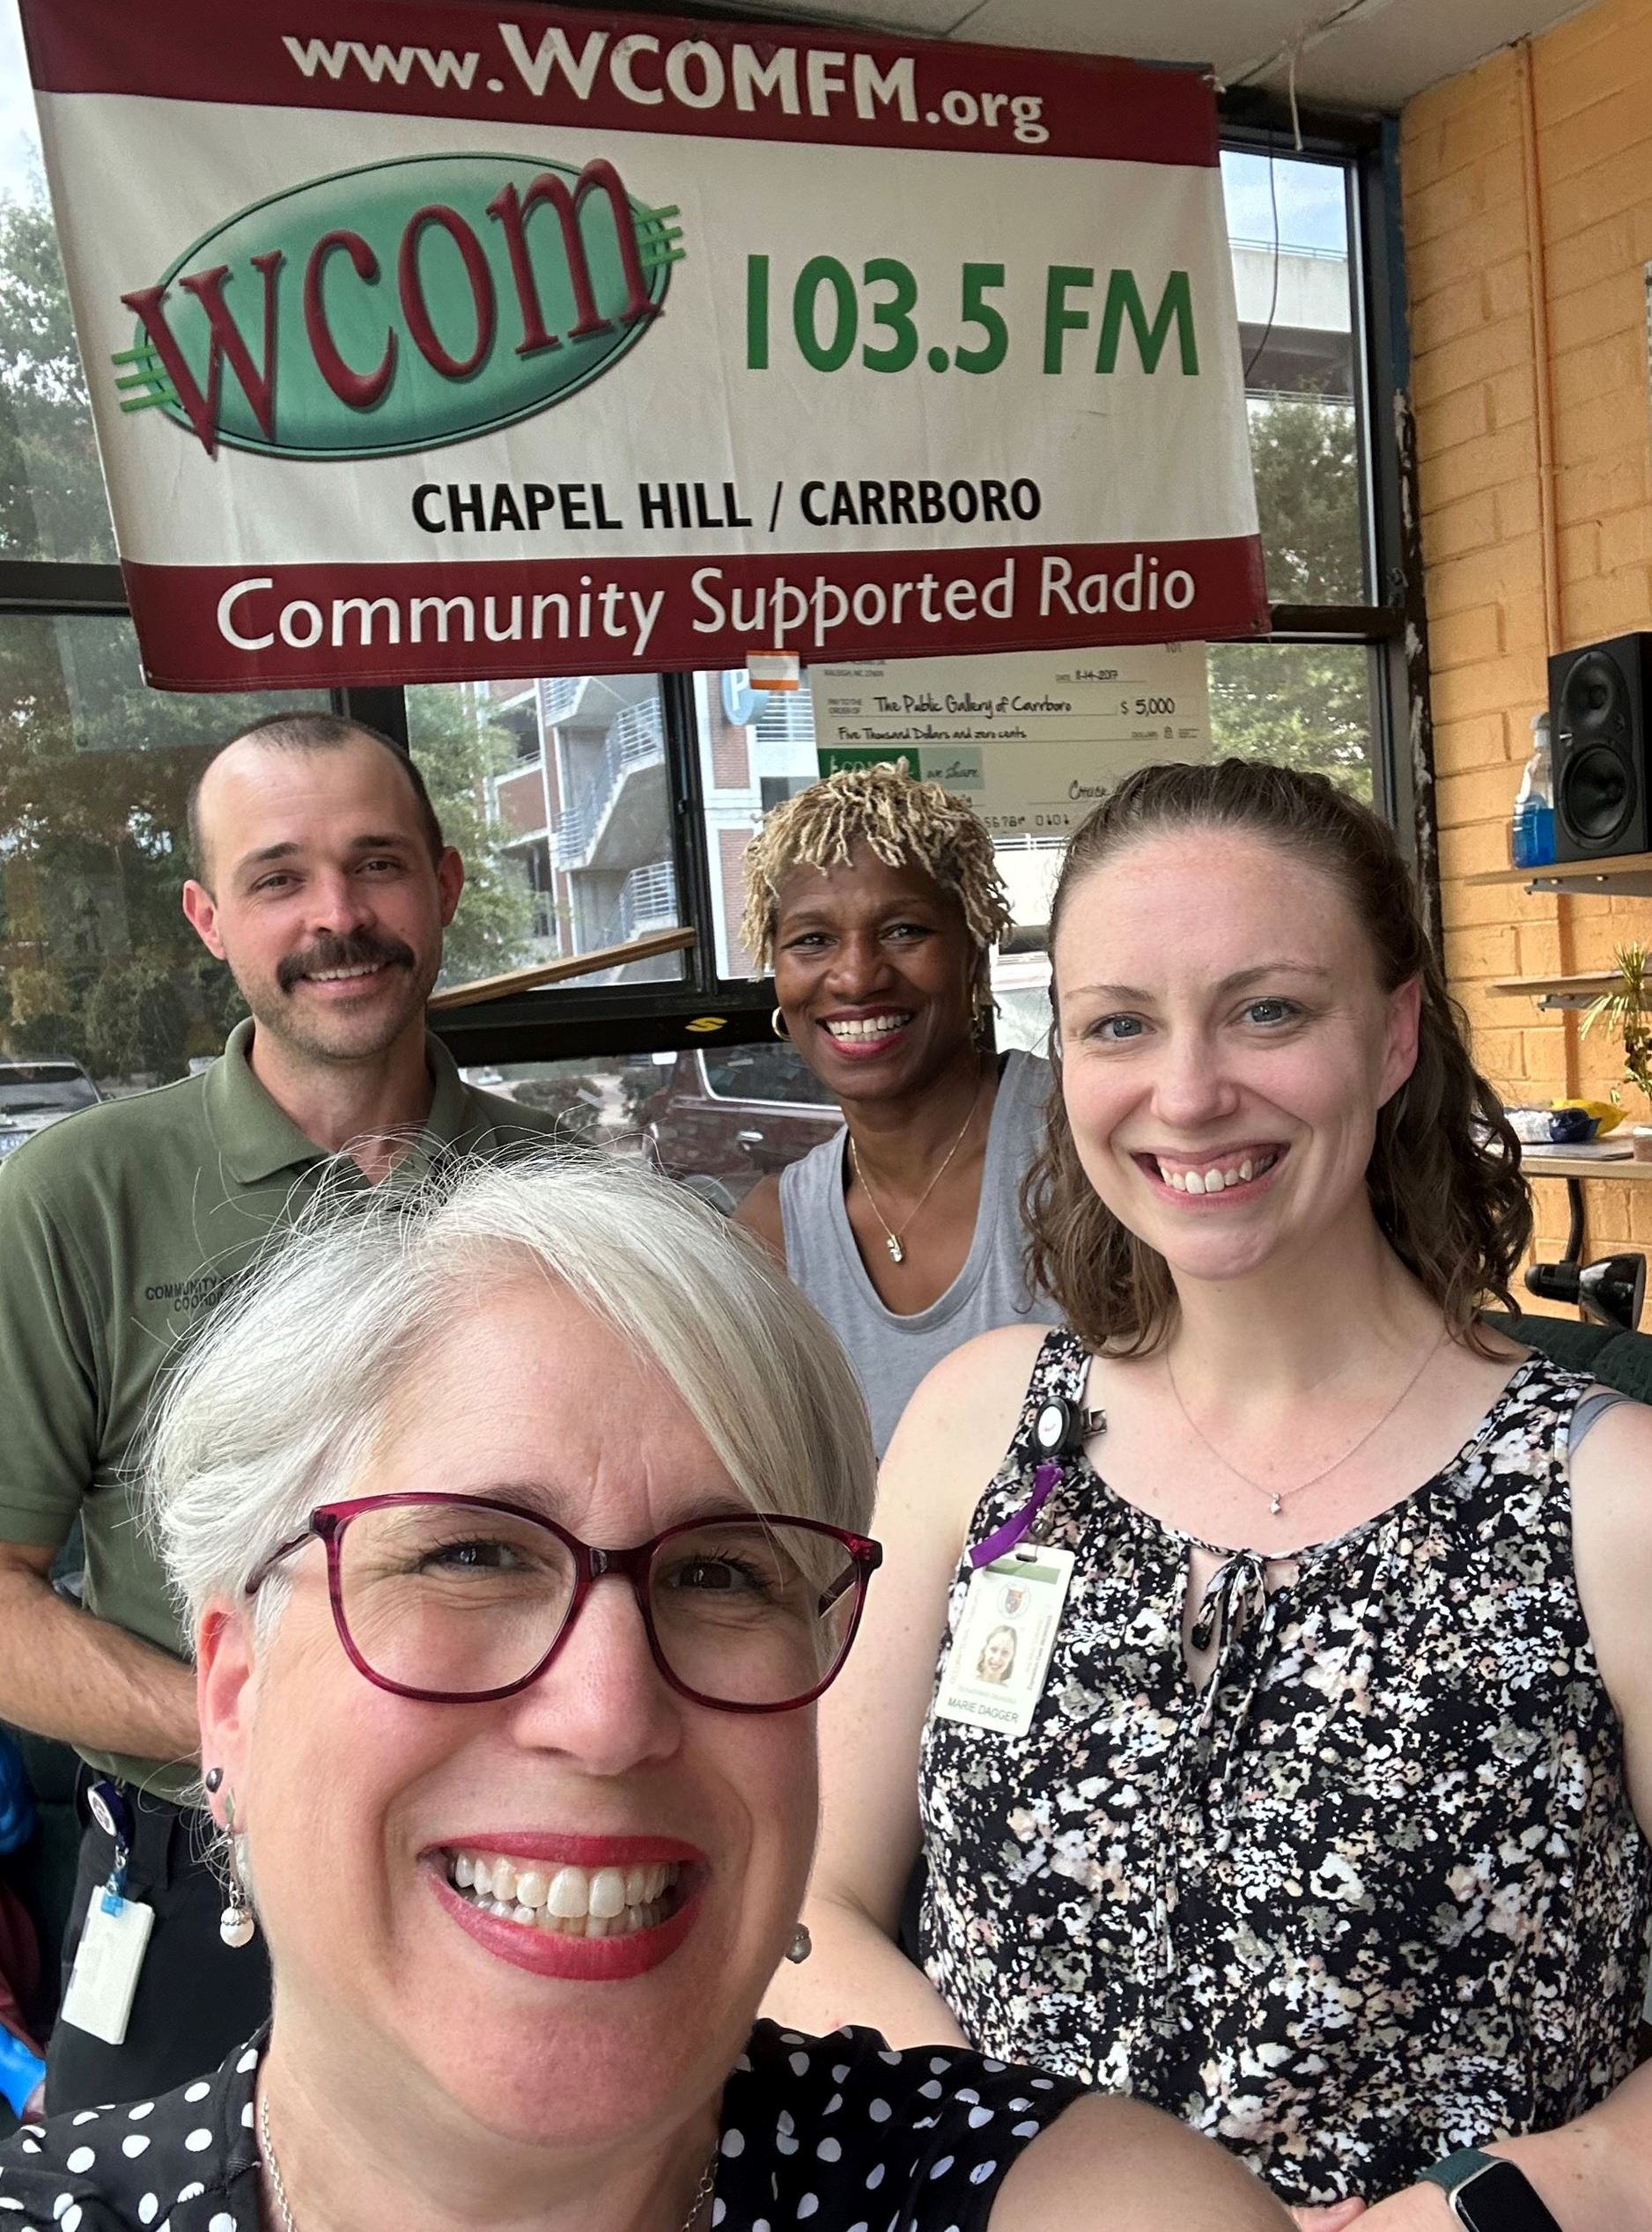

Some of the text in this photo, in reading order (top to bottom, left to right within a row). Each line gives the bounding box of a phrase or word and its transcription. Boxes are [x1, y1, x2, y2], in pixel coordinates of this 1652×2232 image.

[282, 23, 1050, 144] www.WCOMFM.org
[746, 254, 1200, 377] 103.5 FM
[412, 478, 1042, 534] CHAPEL HILL / CARRBORO
[217, 554, 1196, 657] Community Supported Radio
[730, 669, 749, 711] P
[873, 692, 1072, 719] The Public Gallery of Carrboro
[1134, 697, 1176, 717] 5,000
[837, 726, 861, 740] Five
[862, 726, 911, 740] Thousand
[912, 724, 951, 740] Dollars
[952, 727, 972, 740] and
[999, 726, 1028, 740] cents
[145, 1277, 218, 1301] COMMUNITY
[947, 1697, 1020, 1724] MARIE DAGGER
